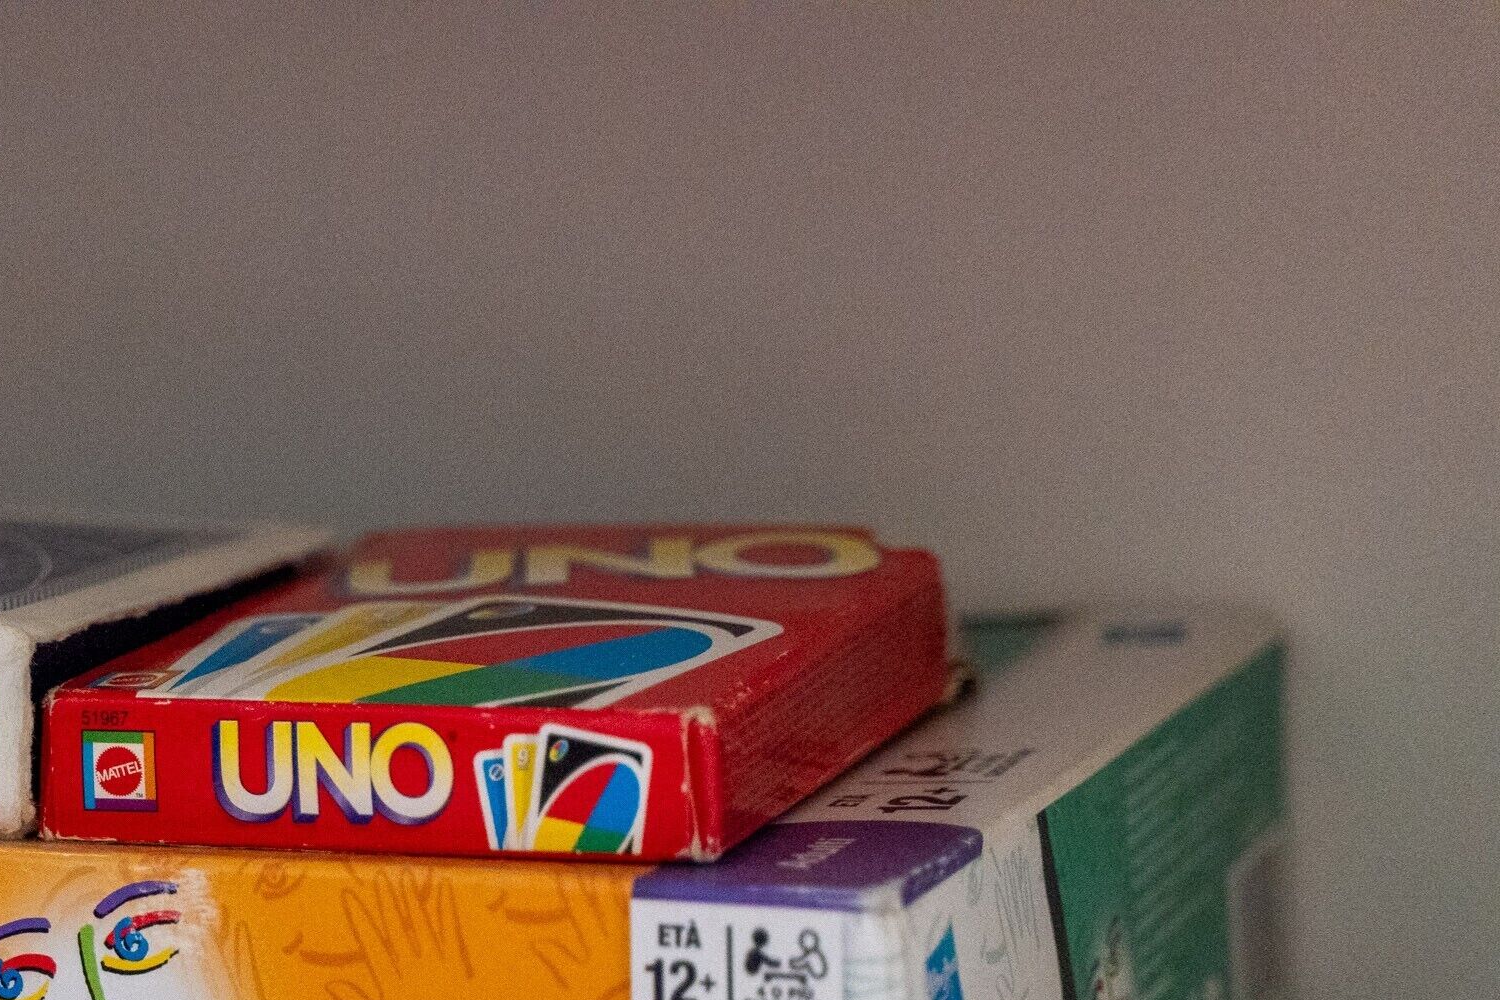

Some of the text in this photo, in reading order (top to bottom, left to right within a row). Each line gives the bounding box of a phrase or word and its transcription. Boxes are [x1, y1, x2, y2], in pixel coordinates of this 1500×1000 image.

[343, 529, 881, 596] UNO
[95, 760, 143, 783] MATTEL
[212, 719, 454, 827] UNO
[657, 918, 702, 950] ETÀ
